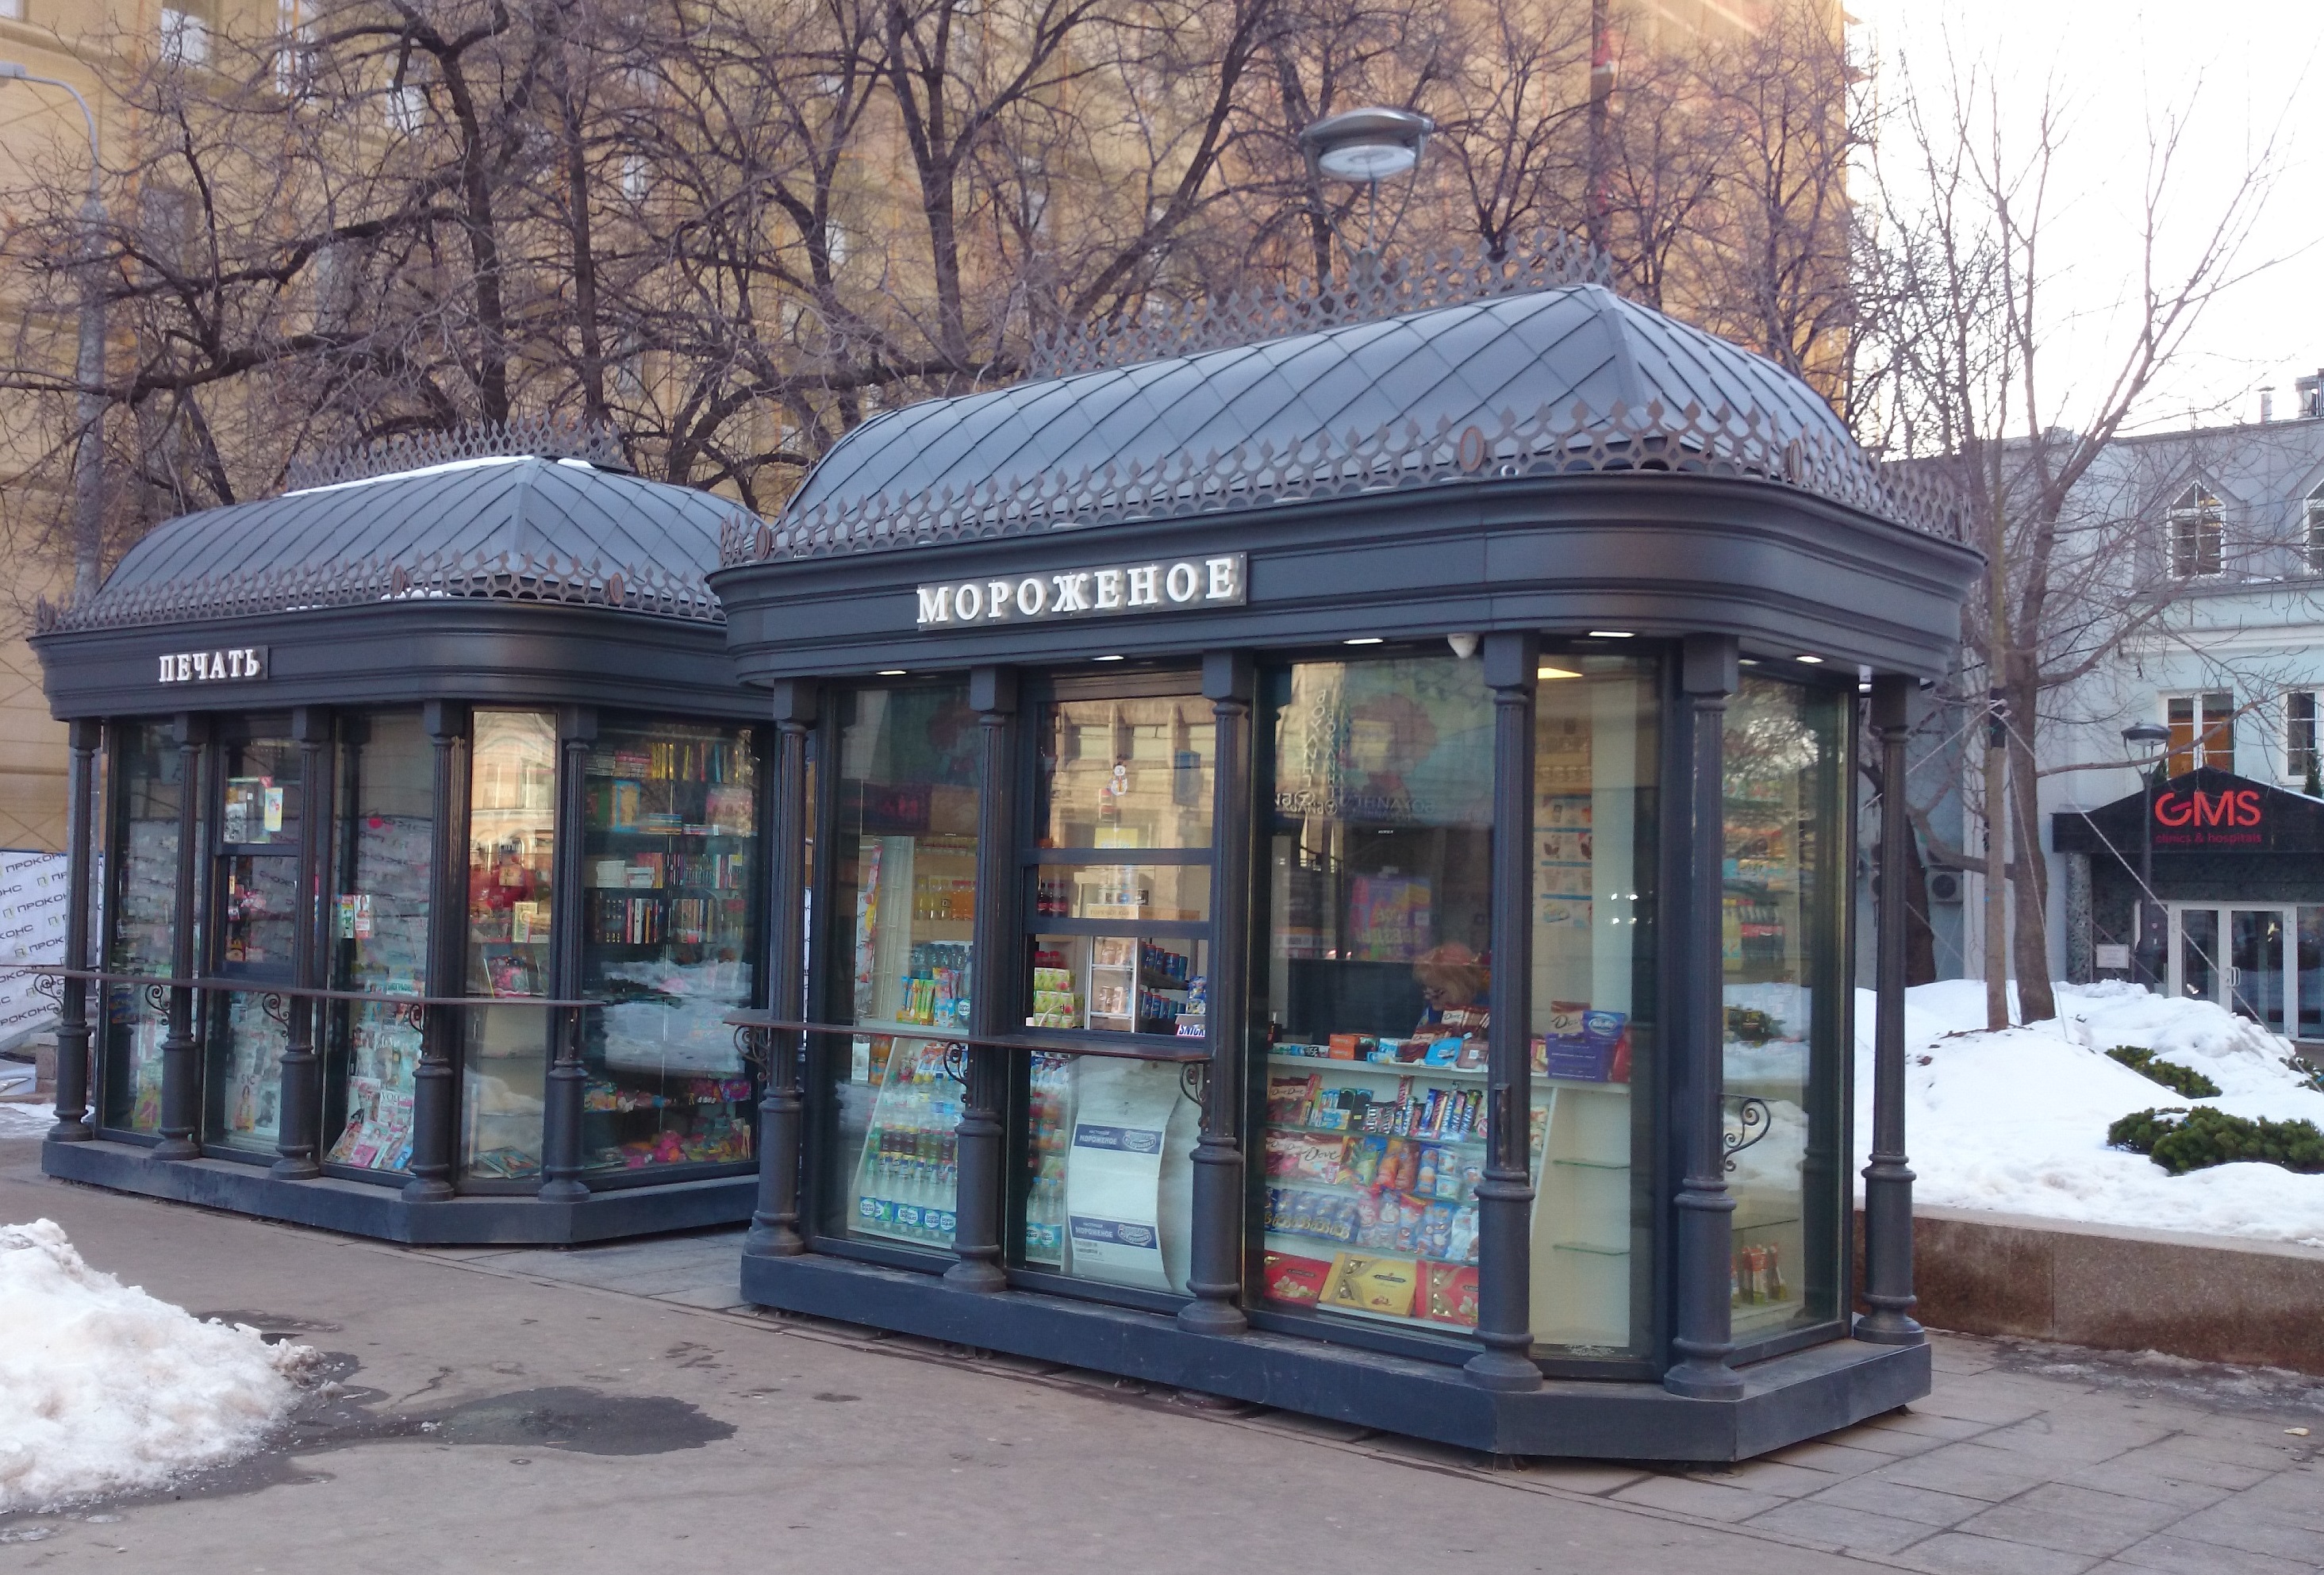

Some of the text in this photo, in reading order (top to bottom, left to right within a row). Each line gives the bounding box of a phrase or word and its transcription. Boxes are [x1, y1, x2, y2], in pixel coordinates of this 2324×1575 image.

[916, 558, 1234, 624] МОРОЖЕНОЕ
[159, 648, 260, 682] ПЕЧАТЬ
[2155, 790, 2261, 826] GMS
[2156, 833, 2261, 845] clinics & hospitals
[6, 853, 62, 873] ПРОКОН
[17, 893, 67, 913] ПРОКО
[29, 936, 64, 953] ПРОК
[0, 1002, 56, 1026] РОКОНС
[1300, 1147, 1343, 1161] Dove
